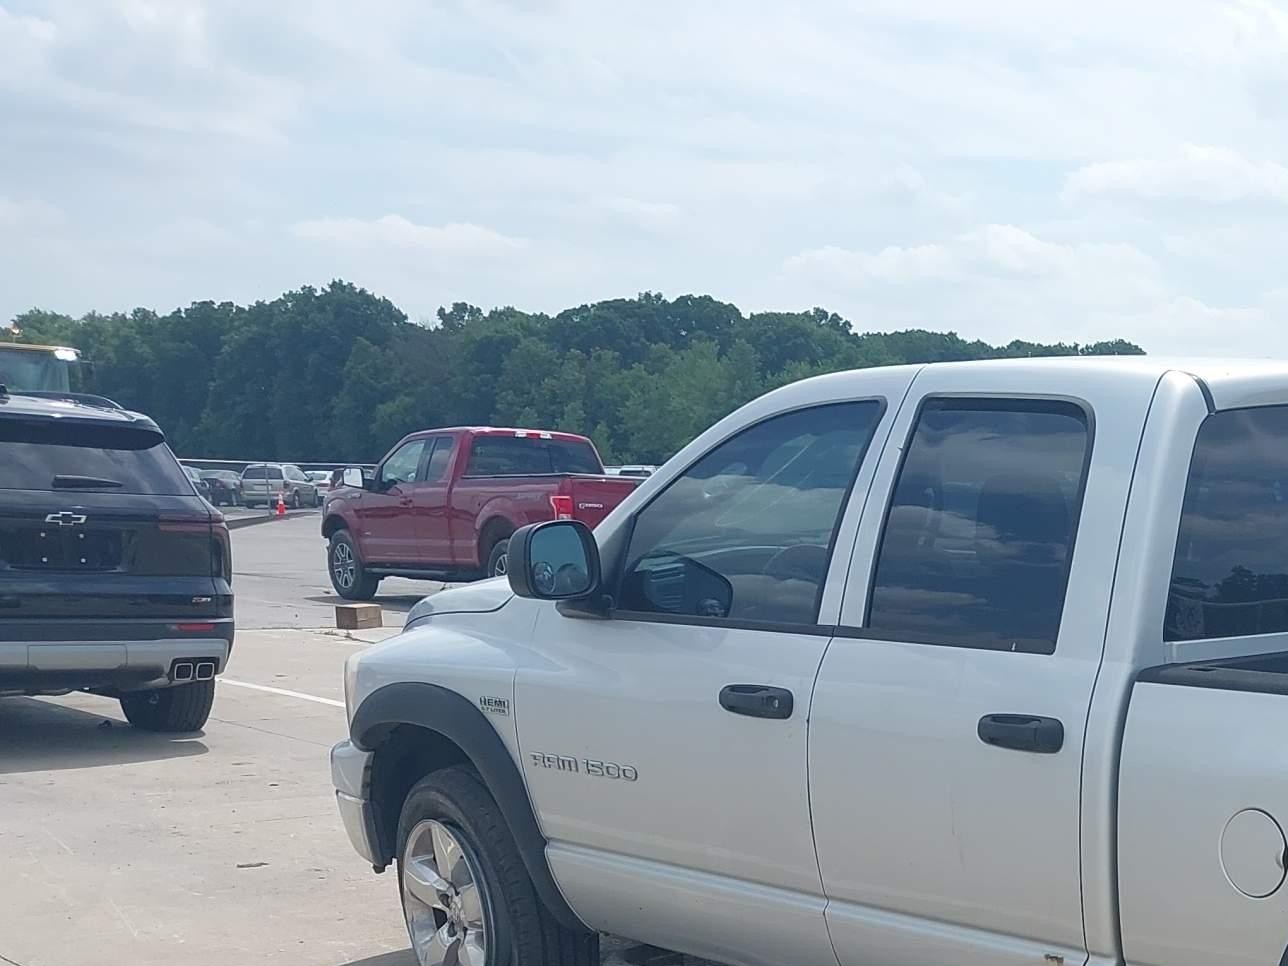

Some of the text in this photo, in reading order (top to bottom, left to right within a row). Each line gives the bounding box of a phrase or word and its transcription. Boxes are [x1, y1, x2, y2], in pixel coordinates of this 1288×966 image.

[480, 696, 506, 709] HEMI
[529, 752, 638, 782] RAM 1500
